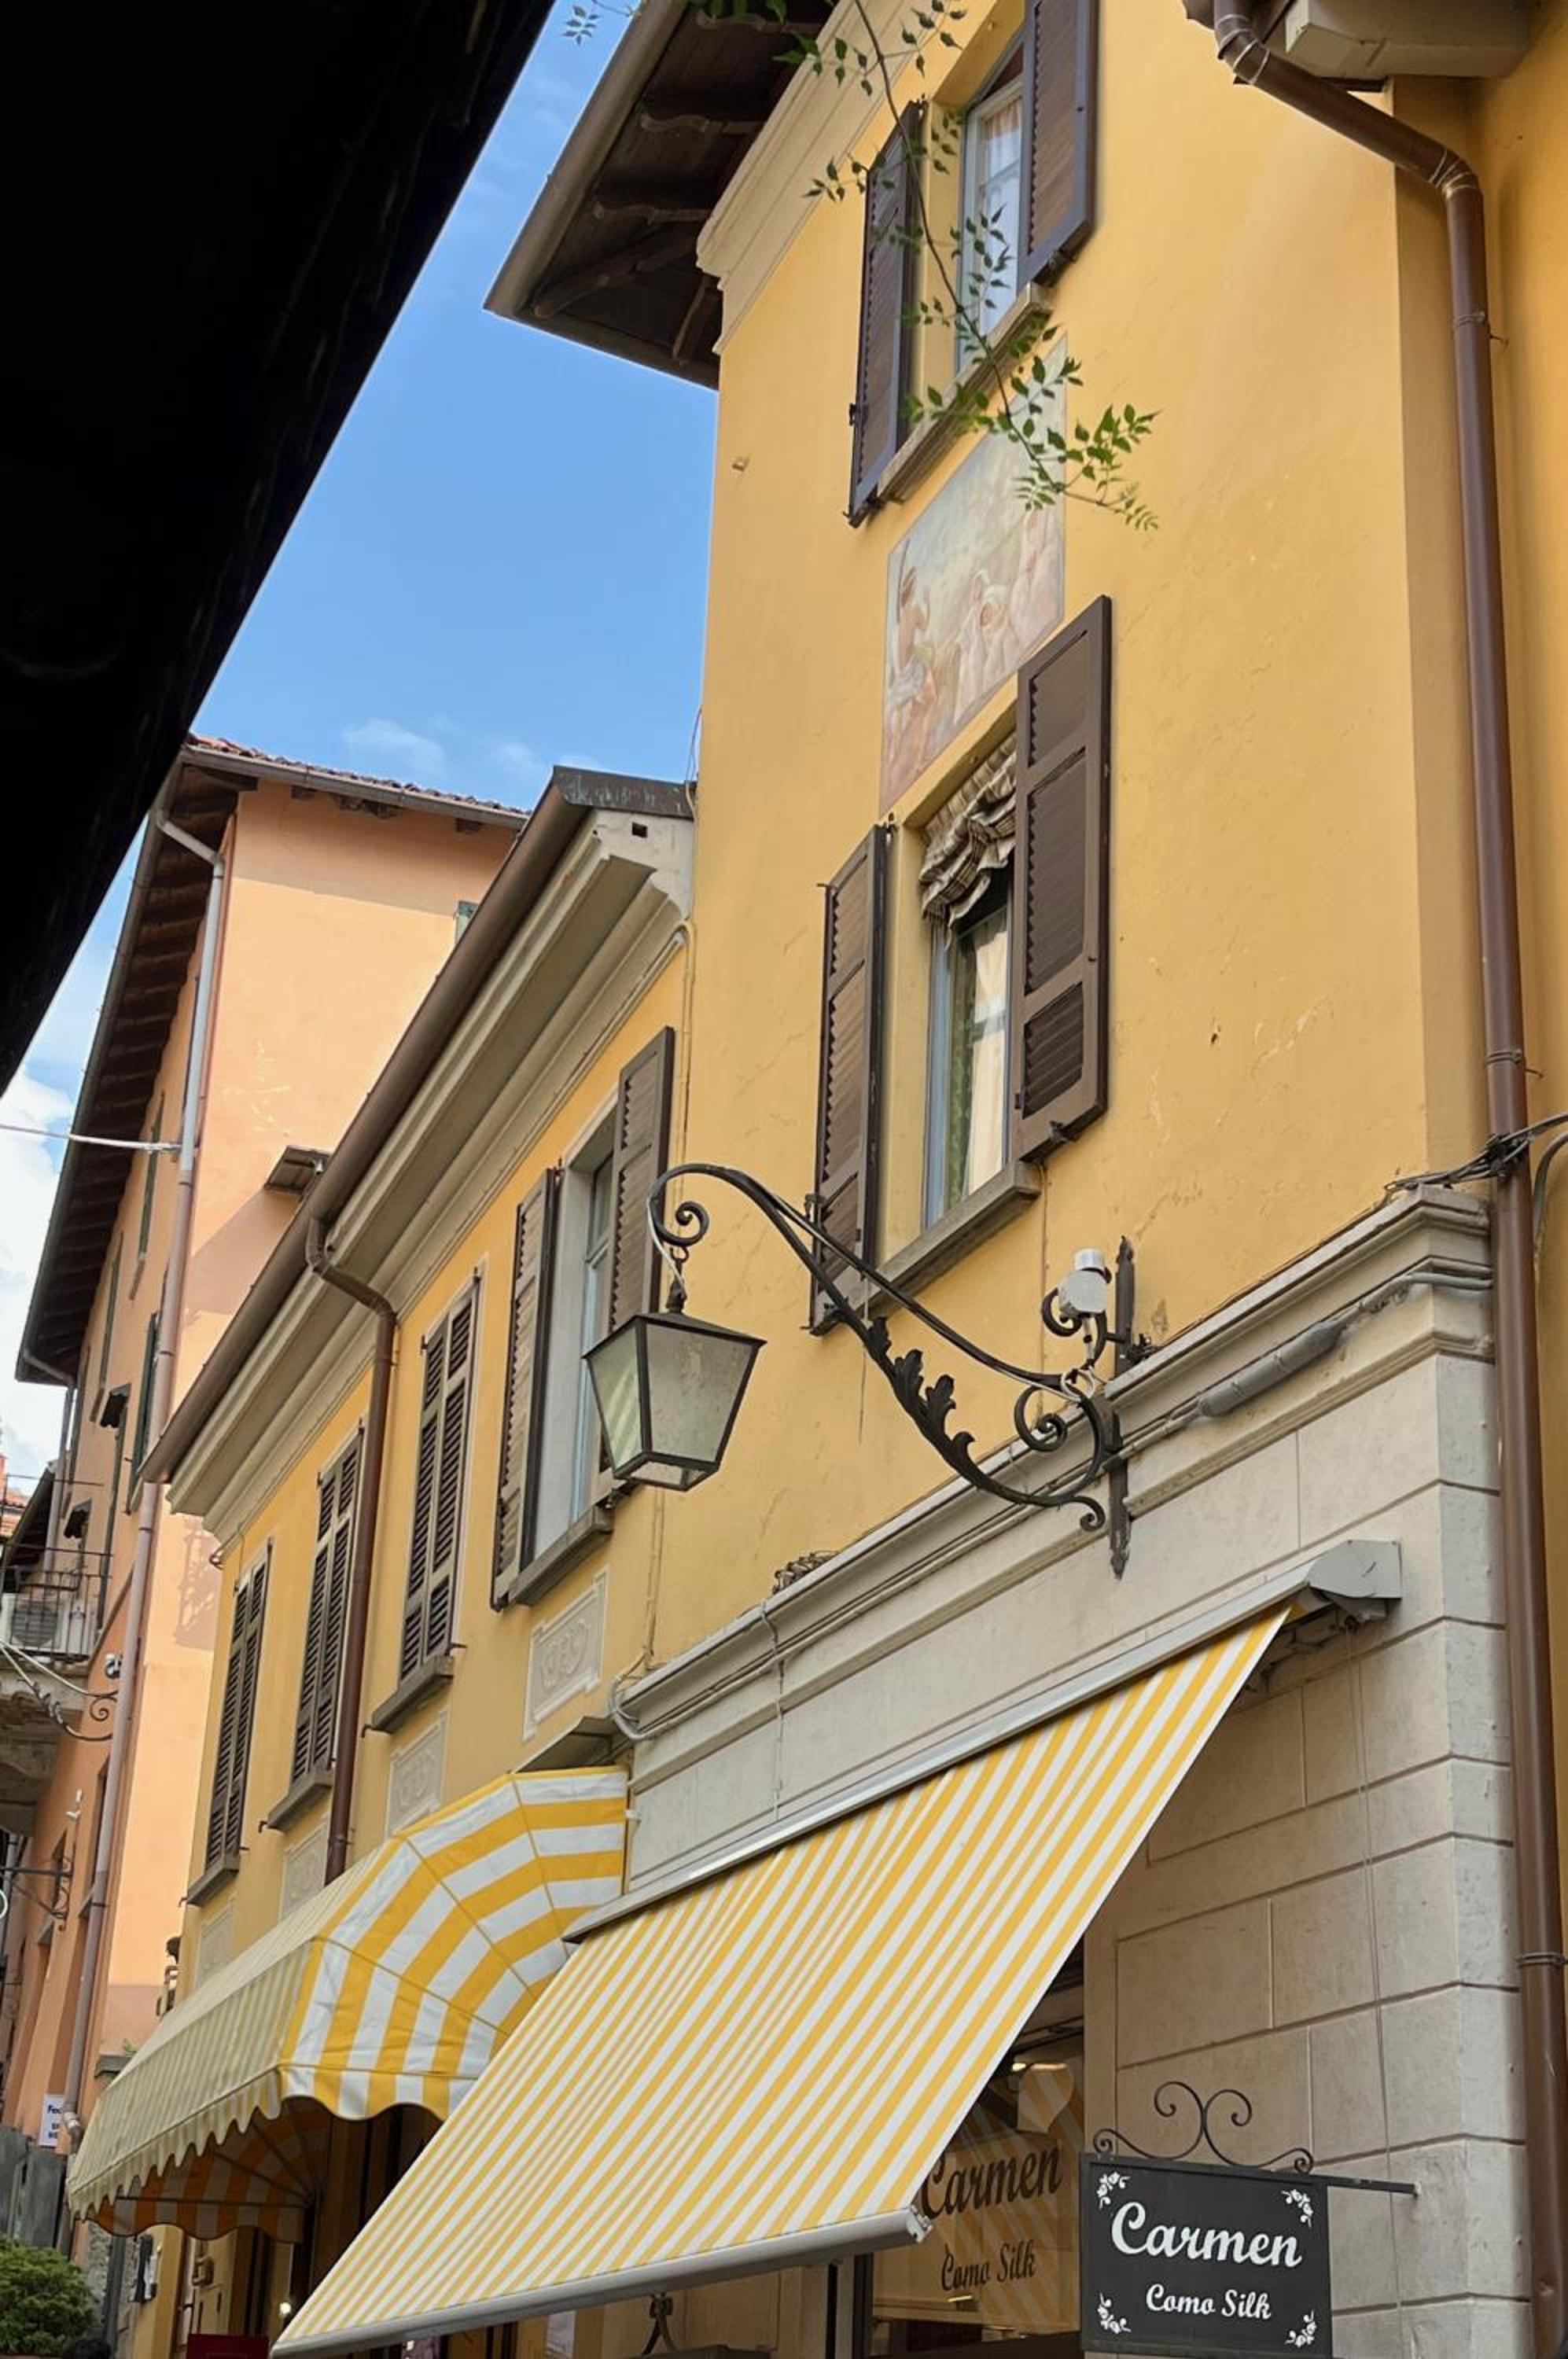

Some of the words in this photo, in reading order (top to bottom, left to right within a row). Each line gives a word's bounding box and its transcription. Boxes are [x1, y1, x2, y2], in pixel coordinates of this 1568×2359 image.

[922, 2147, 1062, 2221] Carmen
[1111, 2202, 1302, 2268] Carmen
[941, 2252, 990, 2291] Como
[996, 2239, 1036, 2283] Silk
[1146, 2284, 1216, 2314] Como
[1221, 2289, 1272, 2320] Silk
